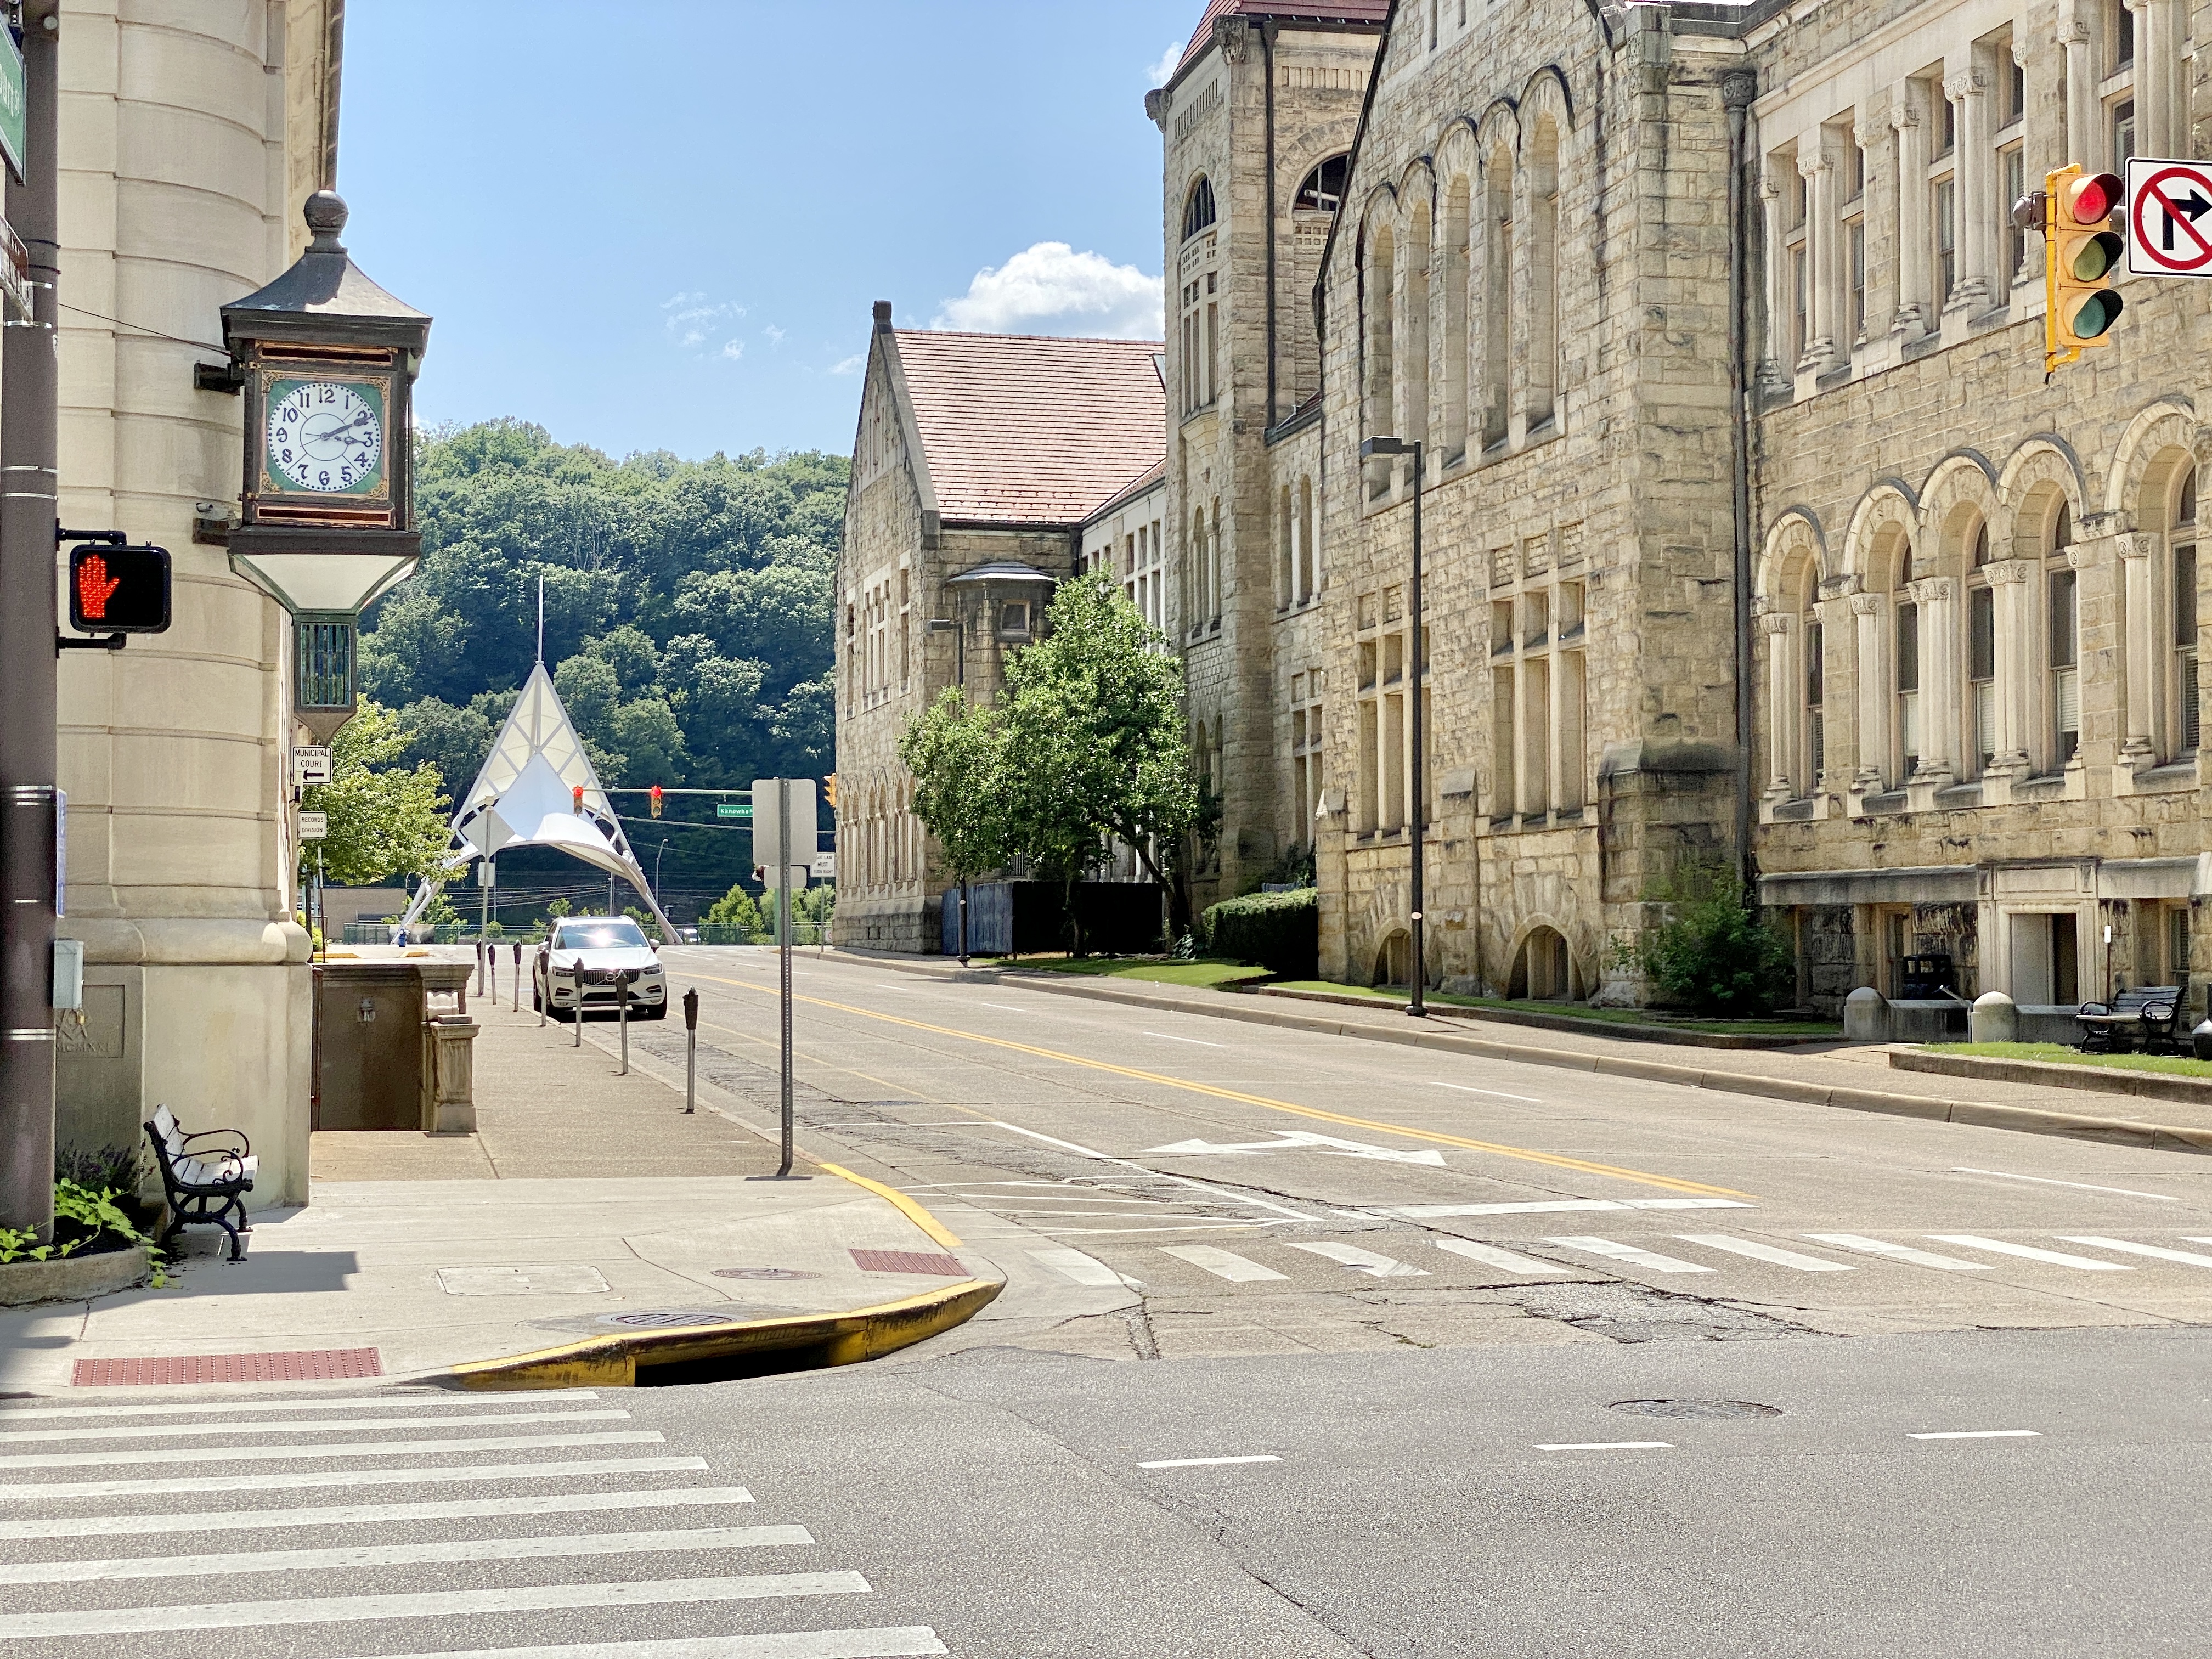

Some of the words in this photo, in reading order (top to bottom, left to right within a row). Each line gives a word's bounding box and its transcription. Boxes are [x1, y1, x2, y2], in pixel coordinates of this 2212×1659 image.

[300, 393, 310, 408] 11
[319, 388, 335, 403] 12
[345, 394, 349, 409] 1
[282, 407, 298, 423] 10
[276, 427, 288, 442] 9
[363, 431, 374, 447] 3
[281, 448, 292, 463] 8
[354, 452, 369, 467] 4
[298, 464, 309, 479] 7
[318, 470, 330, 486] 6
[341, 466, 352, 482] 5
